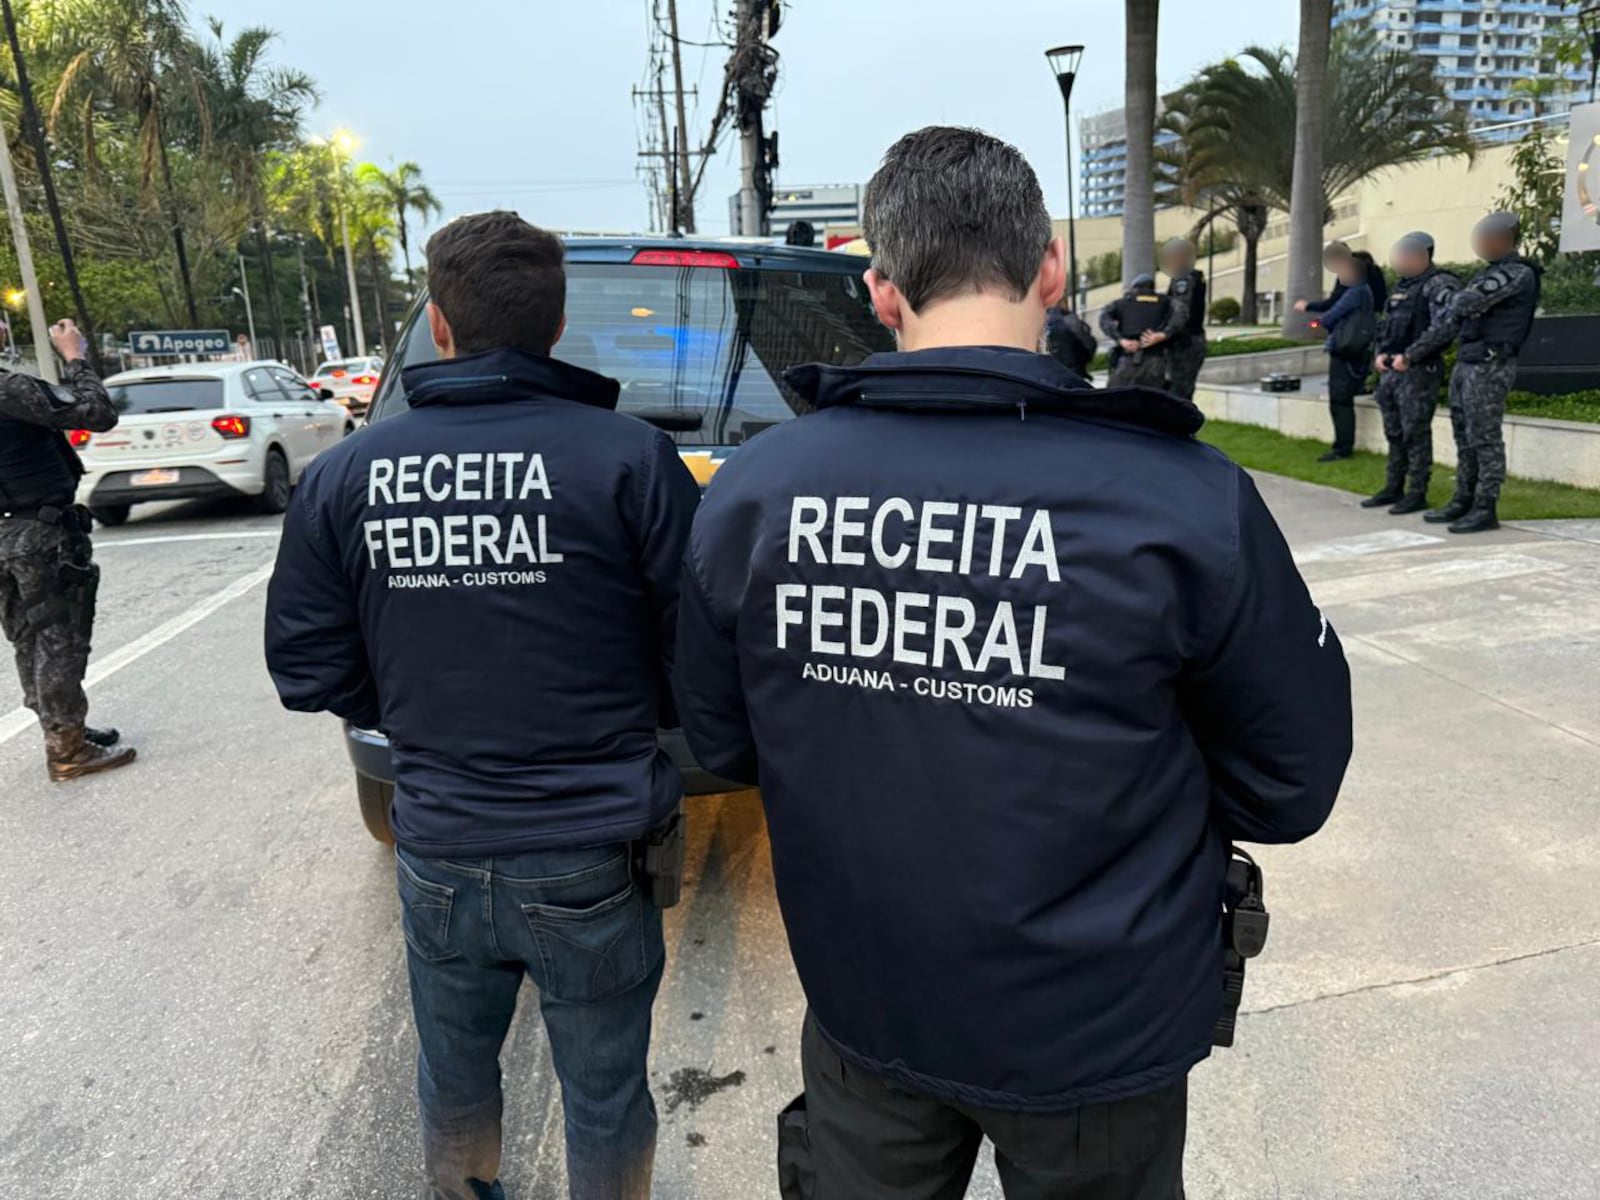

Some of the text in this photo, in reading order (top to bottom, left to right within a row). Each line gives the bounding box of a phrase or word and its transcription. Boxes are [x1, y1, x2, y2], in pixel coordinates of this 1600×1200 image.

[163, 336, 225, 353] Apogeo
[368, 452, 553, 506] RECEITA
[364, 514, 564, 569] FEDERAL
[788, 496, 1061, 582] RECEITA
[388, 574, 449, 589] ADUANA
[462, 570, 547, 586] CUSTOMS
[776, 583, 1066, 681] FEDERAL
[802, 662, 895, 692] ADUANA
[913, 676, 1034, 708] CUSTOMS
